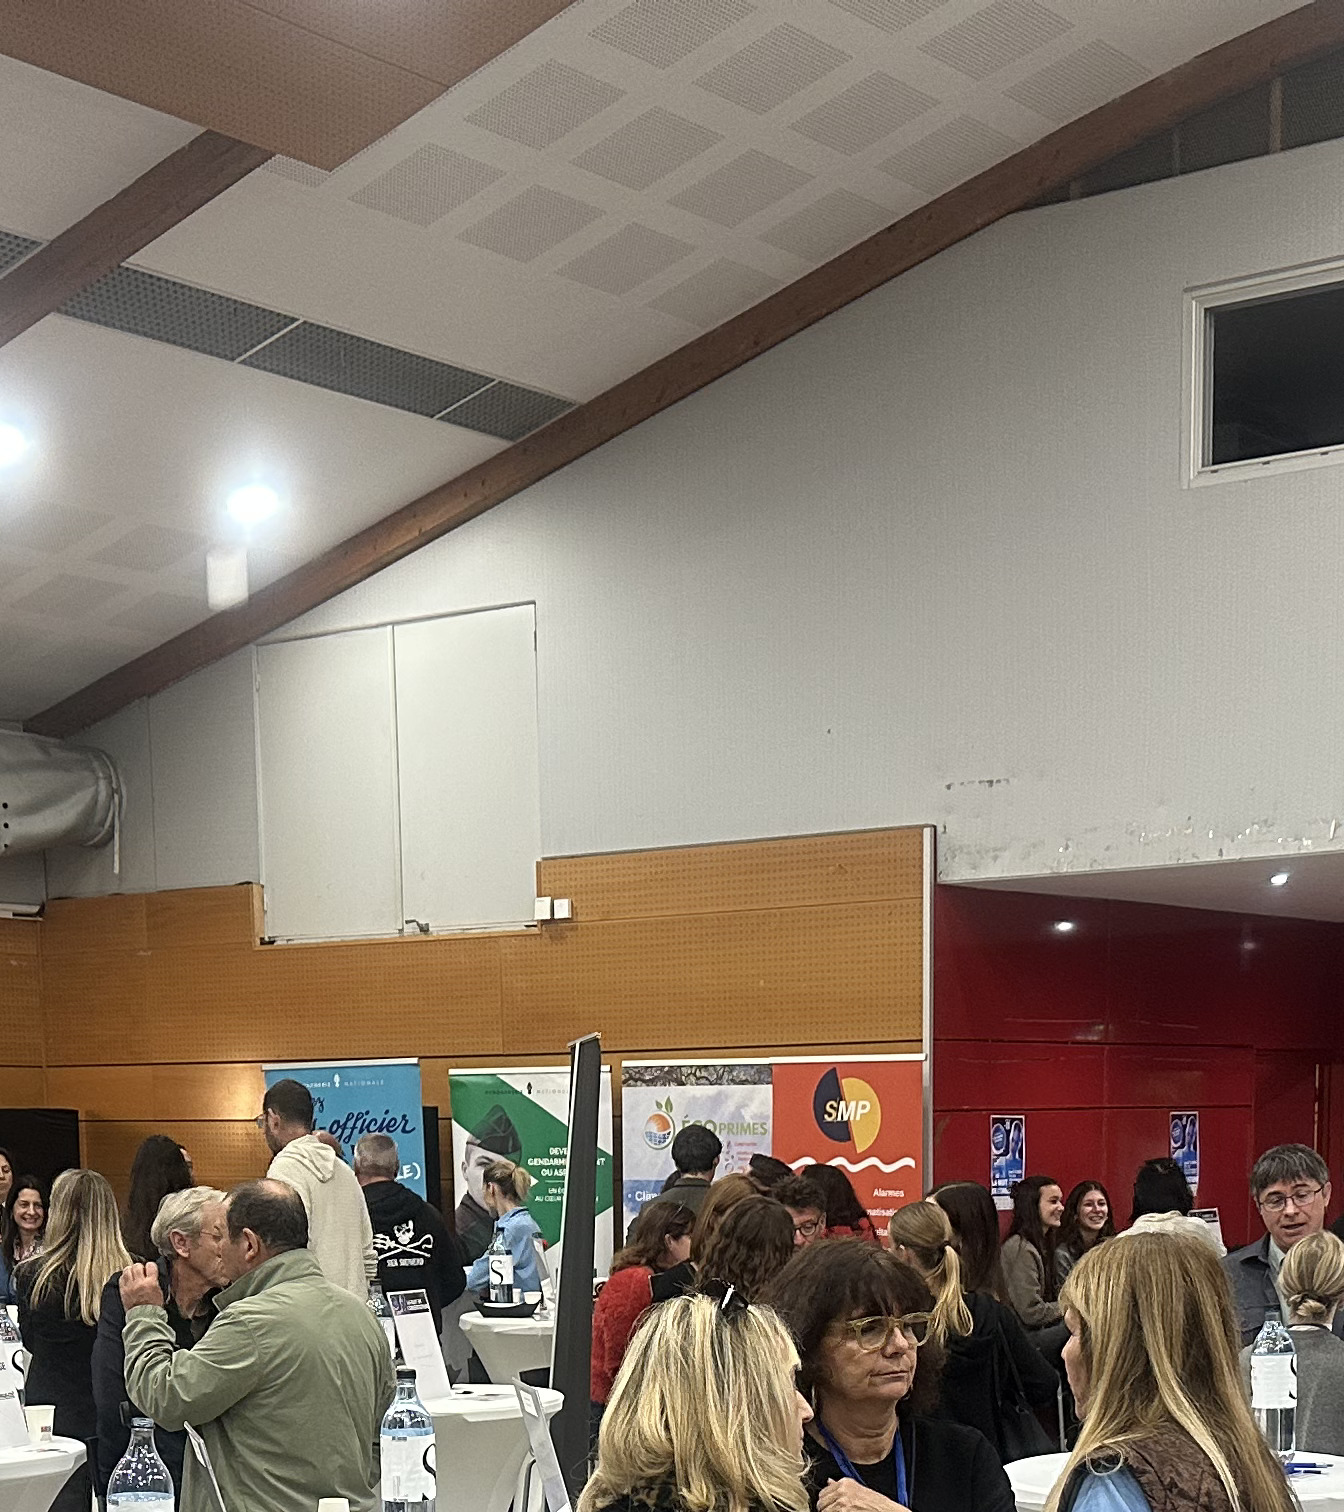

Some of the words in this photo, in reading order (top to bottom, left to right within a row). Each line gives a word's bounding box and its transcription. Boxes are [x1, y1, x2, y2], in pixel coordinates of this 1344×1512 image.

[823, 1100, 871, 1122] SMP
[313, 1109, 416, 1144] -officier
[549, 1147, 567, 1155] DEVE
[528, 1158, 567, 1166] GENDARM
